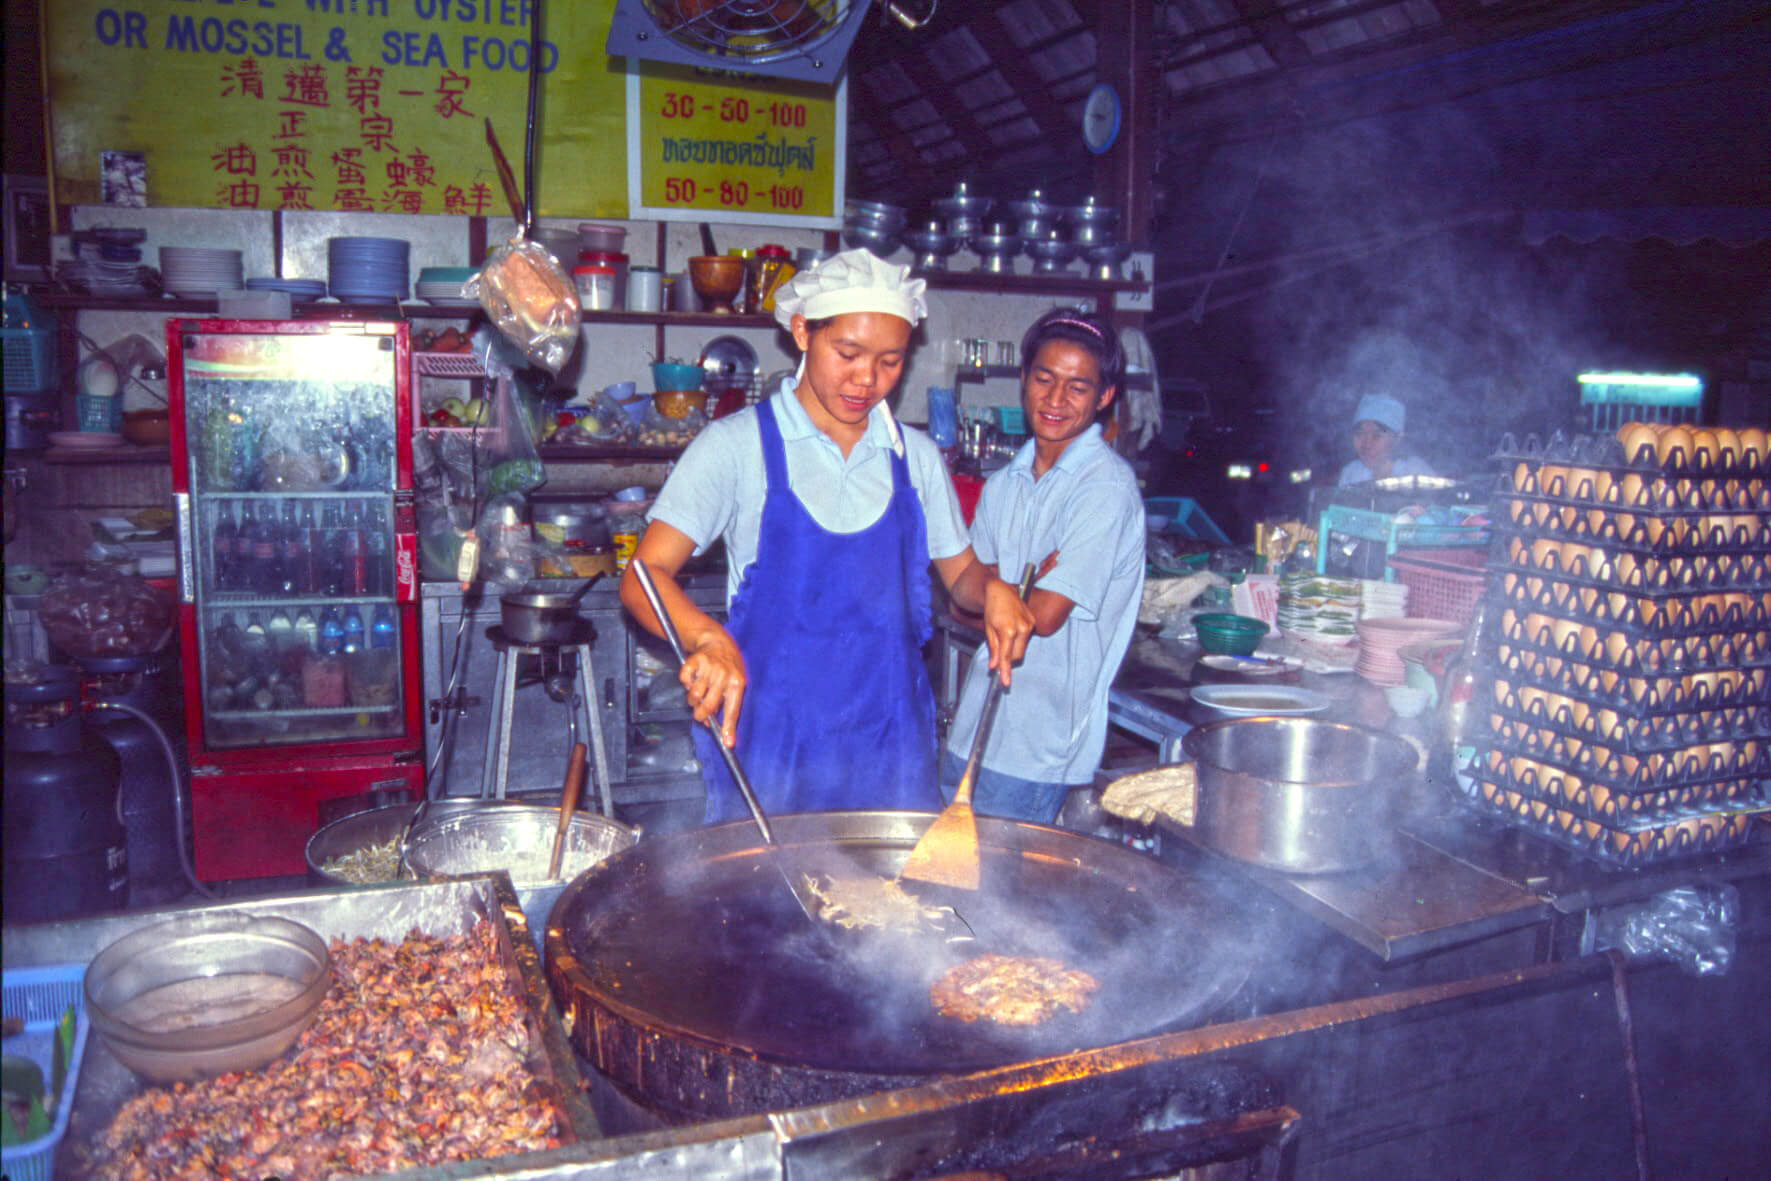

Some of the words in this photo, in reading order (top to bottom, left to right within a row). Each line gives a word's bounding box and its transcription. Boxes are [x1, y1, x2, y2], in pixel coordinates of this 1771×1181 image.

[95, 8, 148, 49] OR
[165, 14, 311, 60] MOSSEL
[323, 26, 352, 62] &
[381, 30, 448, 68] SEA
[462, 35, 559, 74] FOOD
